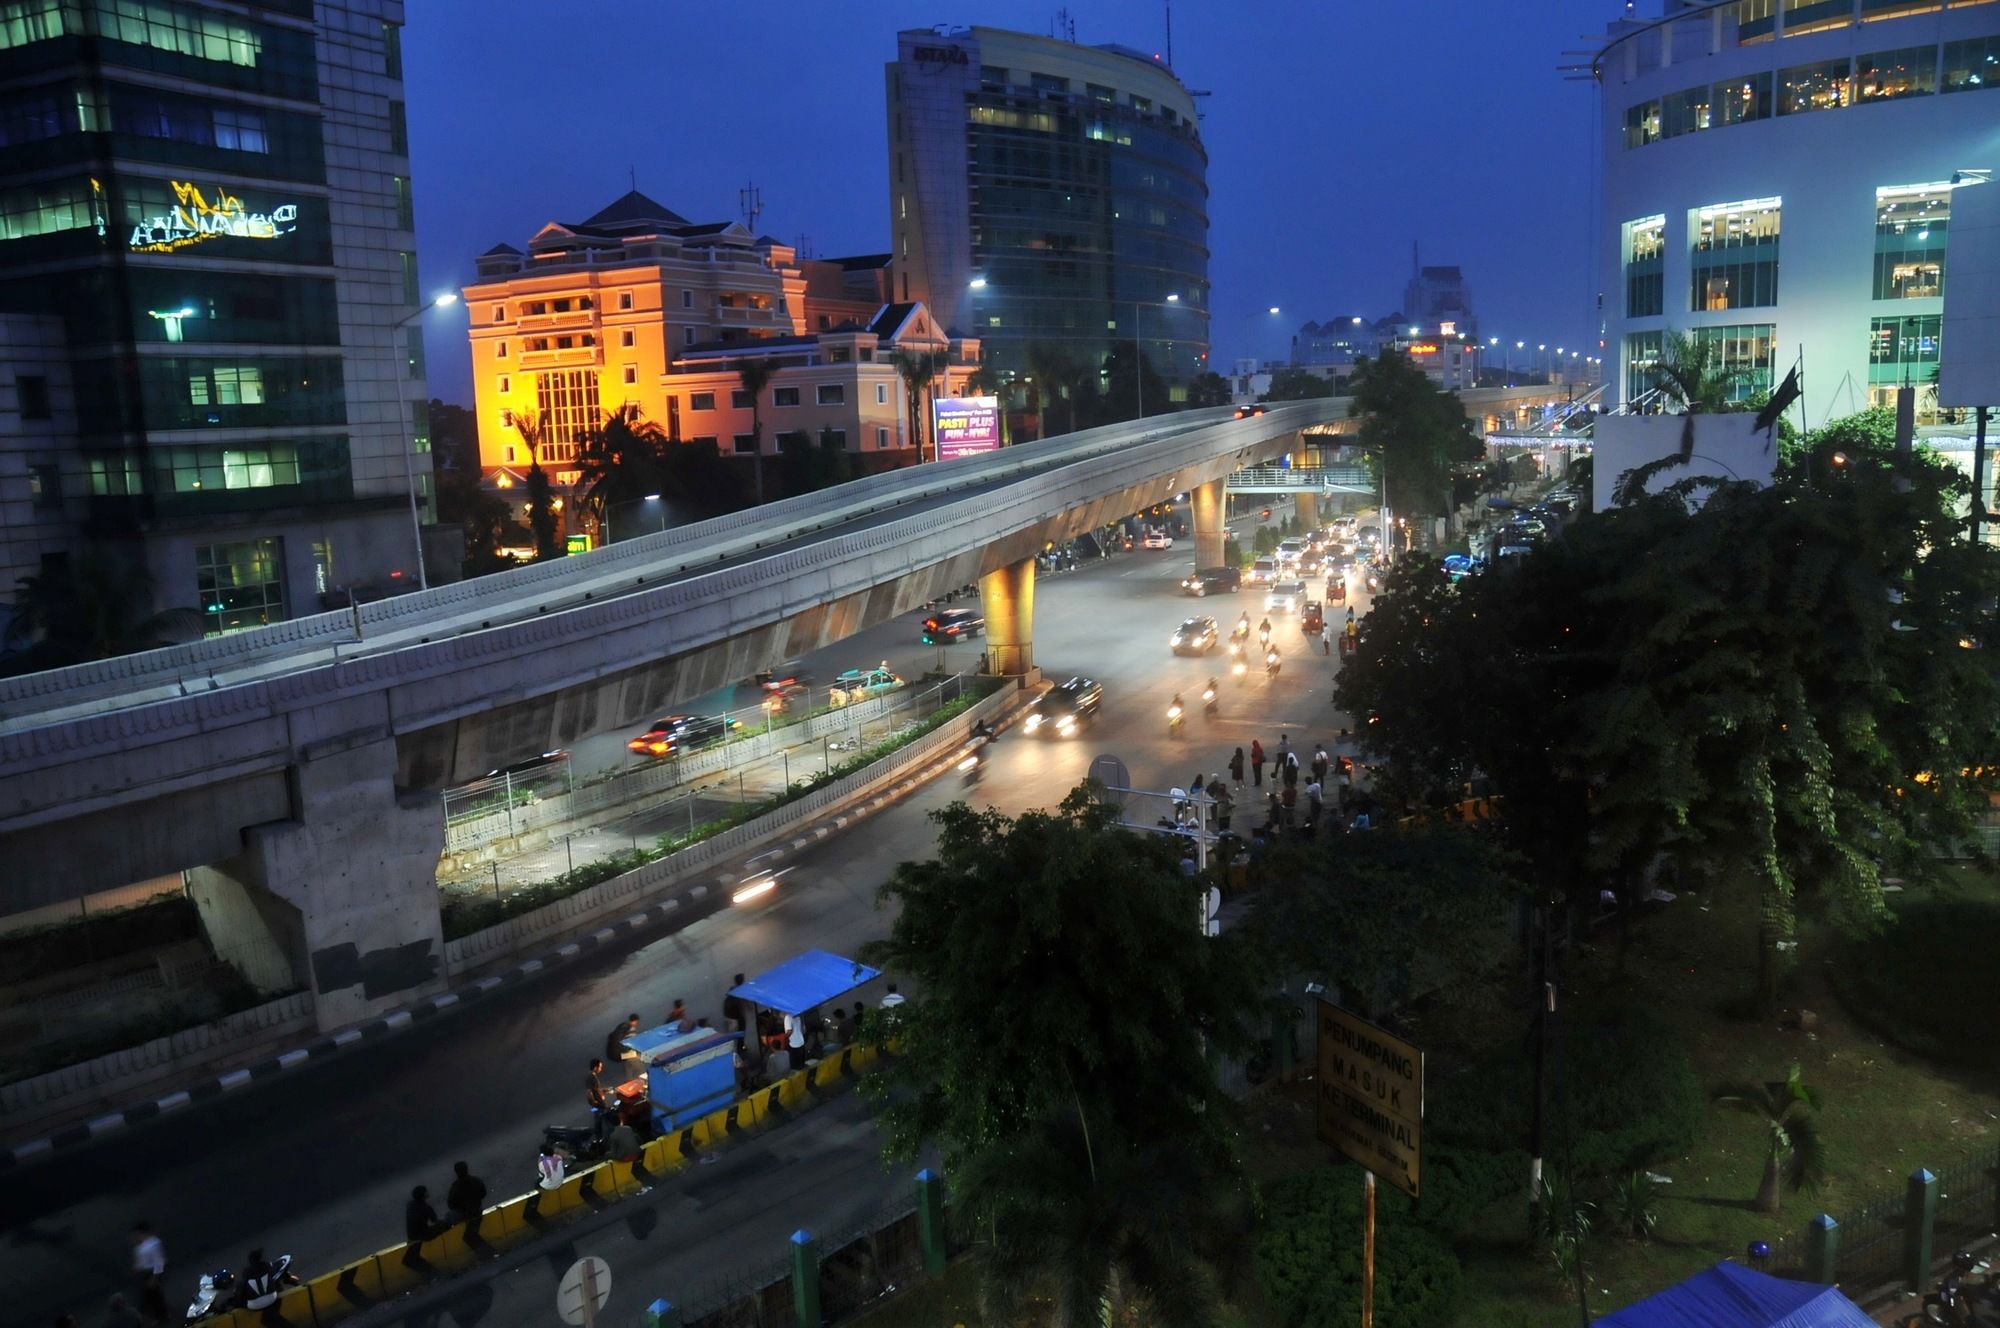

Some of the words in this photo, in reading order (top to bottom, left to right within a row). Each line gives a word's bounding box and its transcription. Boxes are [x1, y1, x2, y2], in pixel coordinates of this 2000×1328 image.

[938, 417, 967, 429] PASTI
[969, 416, 995, 427] PLUS
[567, 540, 585, 552] atm
[1324, 1016, 1413, 1081] PENUMPANG
